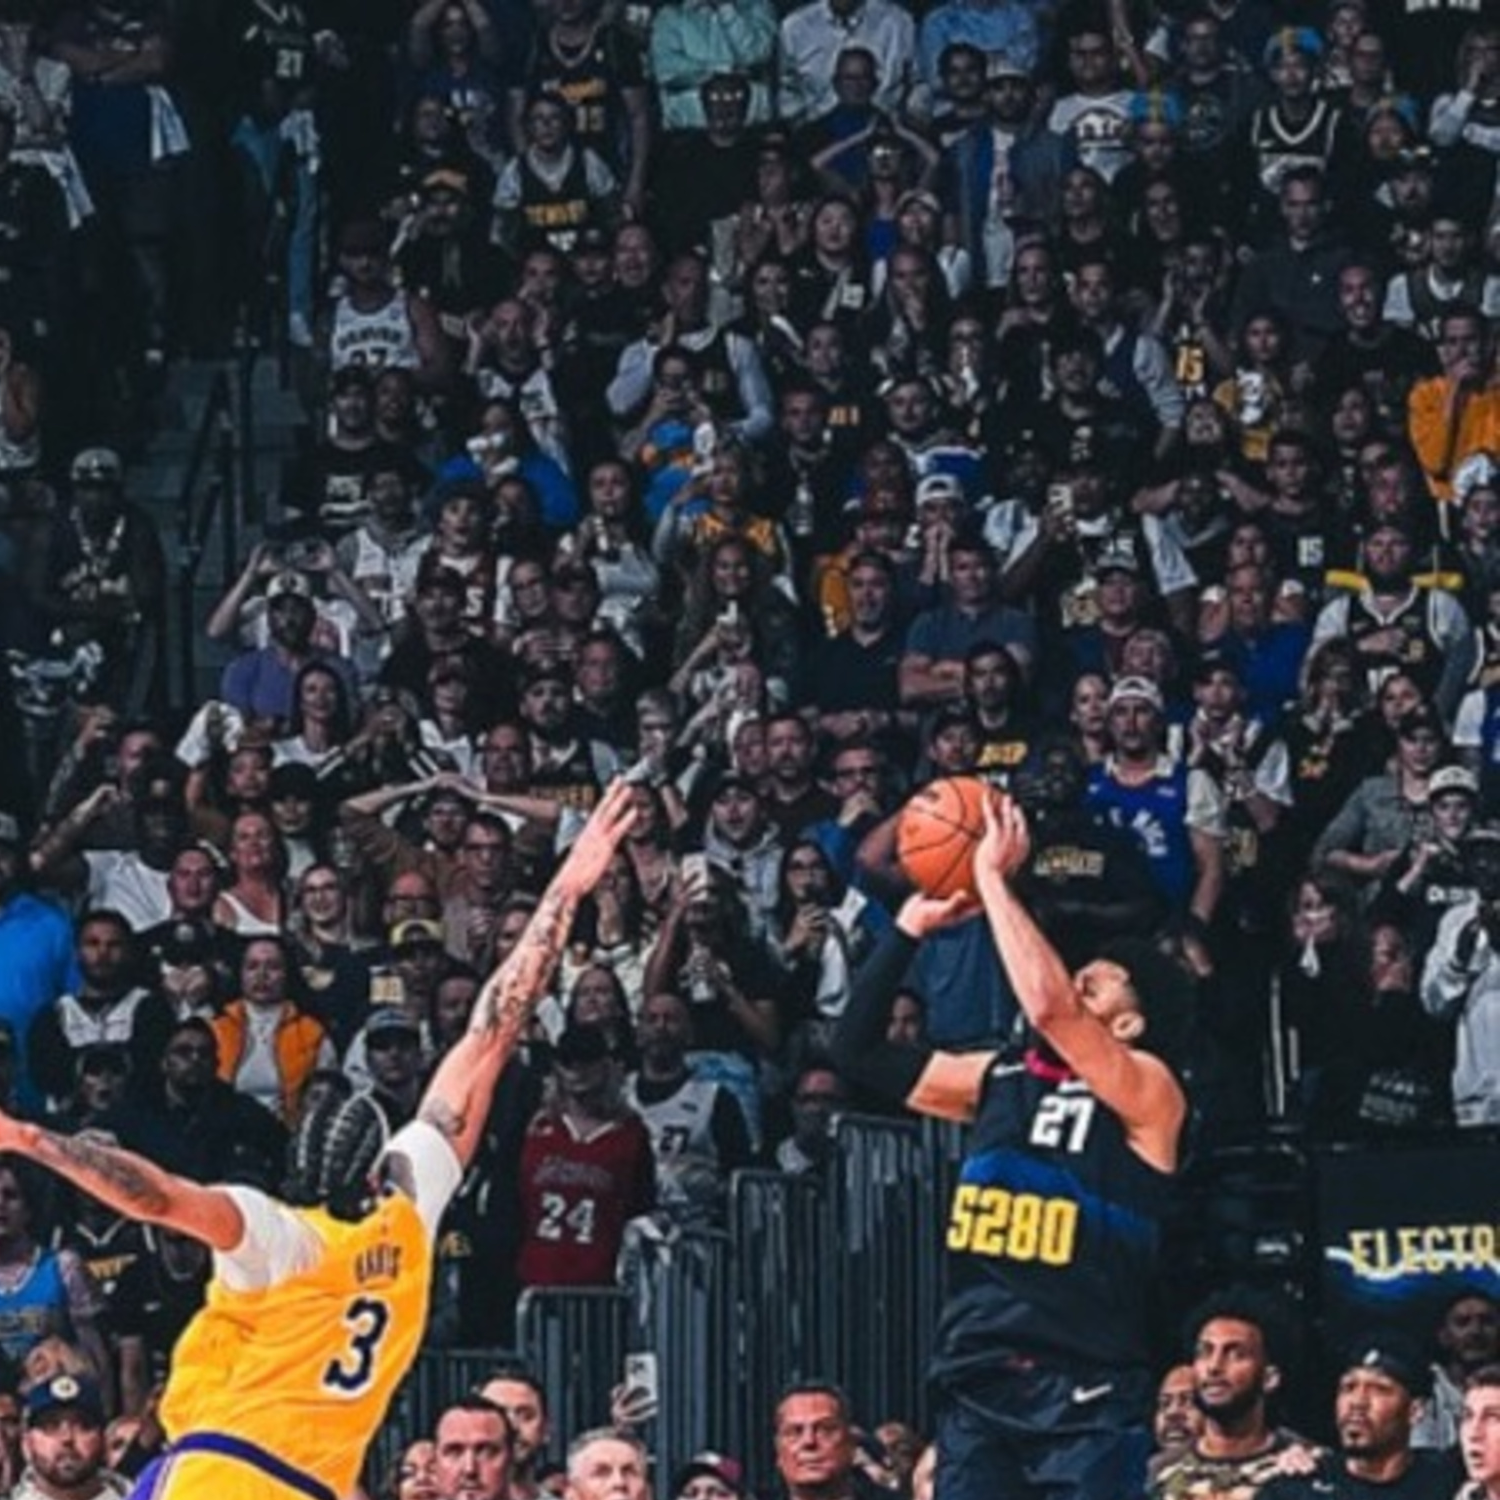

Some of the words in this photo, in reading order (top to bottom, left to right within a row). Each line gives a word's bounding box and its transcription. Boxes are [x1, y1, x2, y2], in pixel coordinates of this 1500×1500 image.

[1031, 1094, 1095, 1153] 27
[537, 1191, 595, 1245] 24
[946, 1184, 1078, 1266] 5280
[324, 1297, 389, 1391] 3
